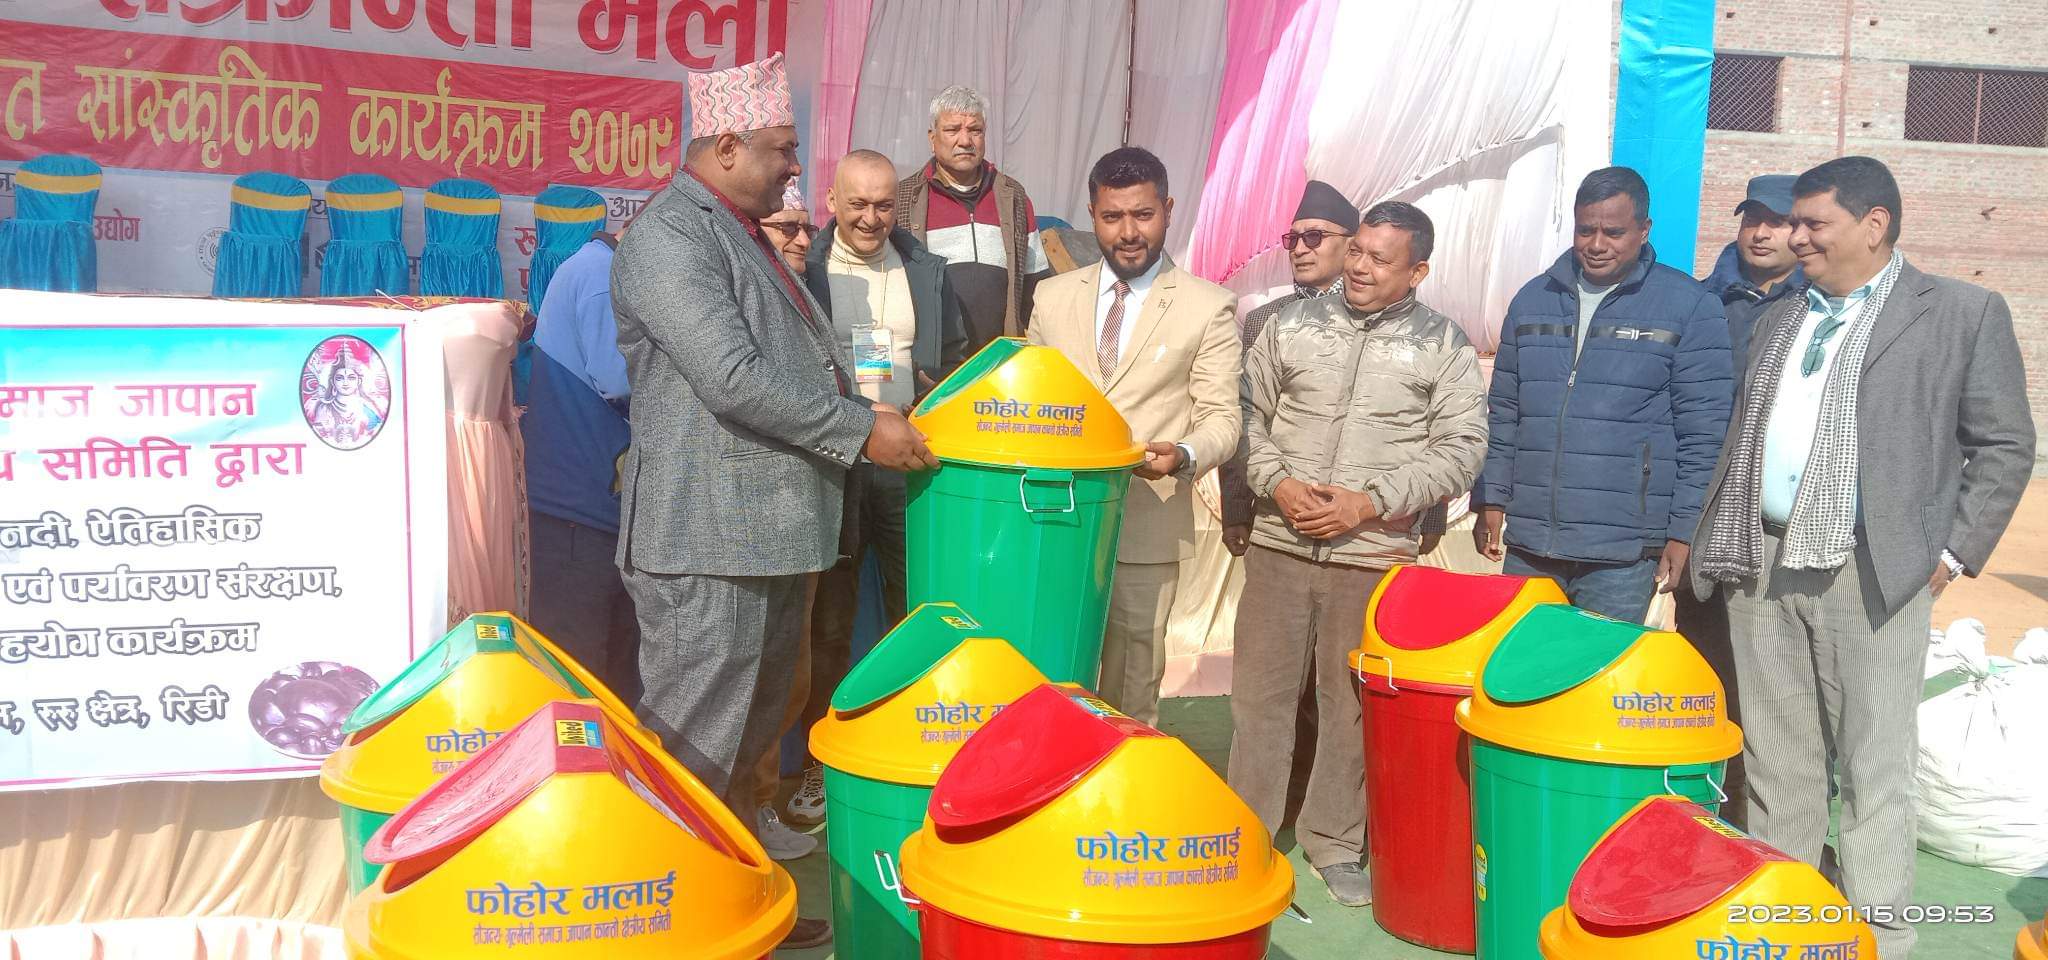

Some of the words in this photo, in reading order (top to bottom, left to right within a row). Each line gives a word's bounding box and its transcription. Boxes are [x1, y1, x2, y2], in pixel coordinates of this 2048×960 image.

[75, 46, 322, 168] सांस्कृतिक
[347, 67, 546, 177] कार्यक्रम
[568, 107, 674, 181] २०७९
[115, 384, 257, 417] जापान
[973, 398, 1033, 418] फोहोर
[1037, 404, 1087, 423] मलाई
[38, 436, 191, 481] समिति
[210, 443, 306, 488] द्वारा
[86, 505, 262, 546] ऐतिहासिक
[2, 568, 53, 604] एवं
[60, 564, 211, 602] पर्यावरण
[217, 562, 342, 601] संरक्षण,
[107, 618, 259, 655] कार्यक्रम
[159, 685, 229, 725] रिडी
[915, 701, 985, 724] फोहोर
[1612, 692, 1677, 713] फोहोर
[1680, 691, 1716, 712] मलाई
[1076, 832, 1170, 863] फोहोर
[1178, 827, 1241, 859] मलाई
[466, 882, 574, 918] फोहोर
[583, 870, 677, 910] मलाई
